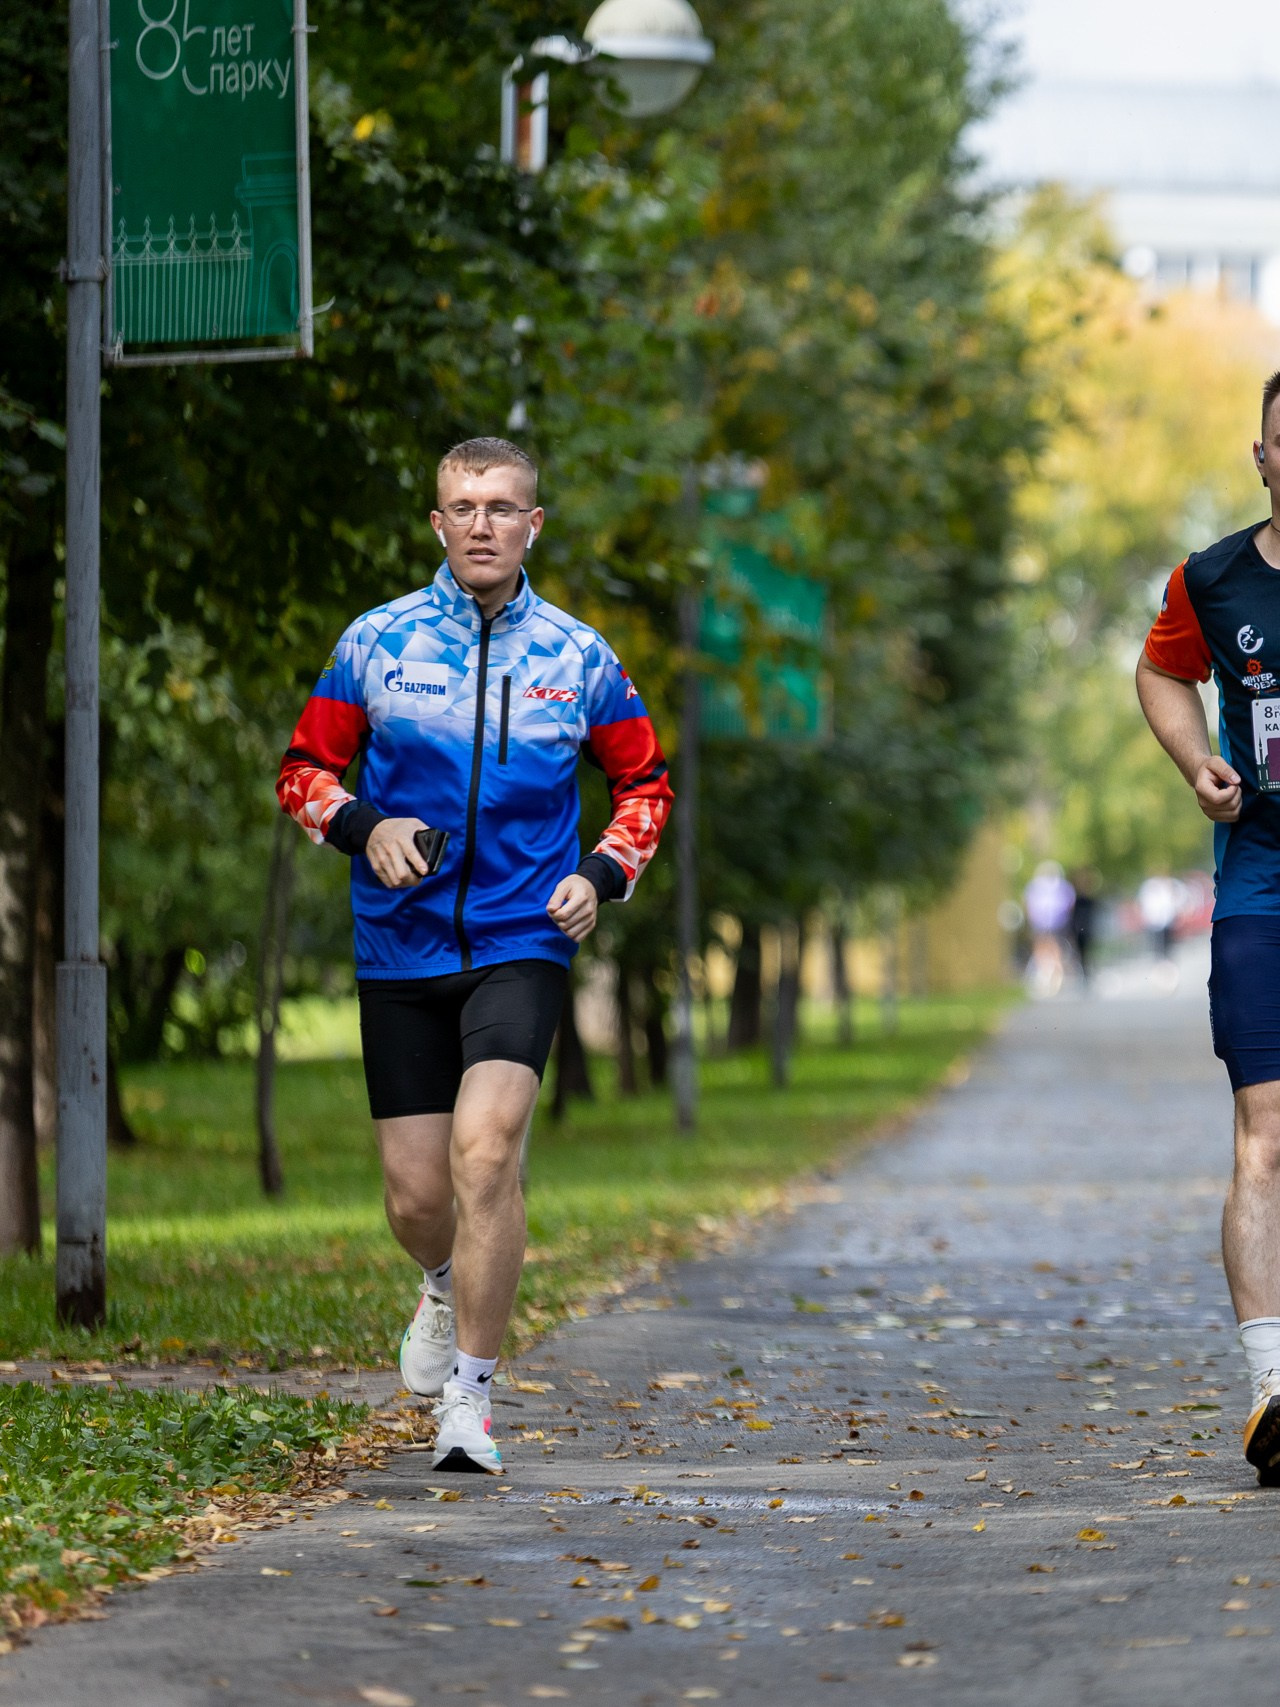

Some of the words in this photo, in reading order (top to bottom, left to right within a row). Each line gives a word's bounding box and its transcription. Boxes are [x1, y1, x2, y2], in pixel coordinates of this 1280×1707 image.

[210, 24, 255, 58] лет
[210, 57, 290, 102] парку
[404, 681, 447, 696] GAZPROM
[1264, 706, 1274, 719] 8
